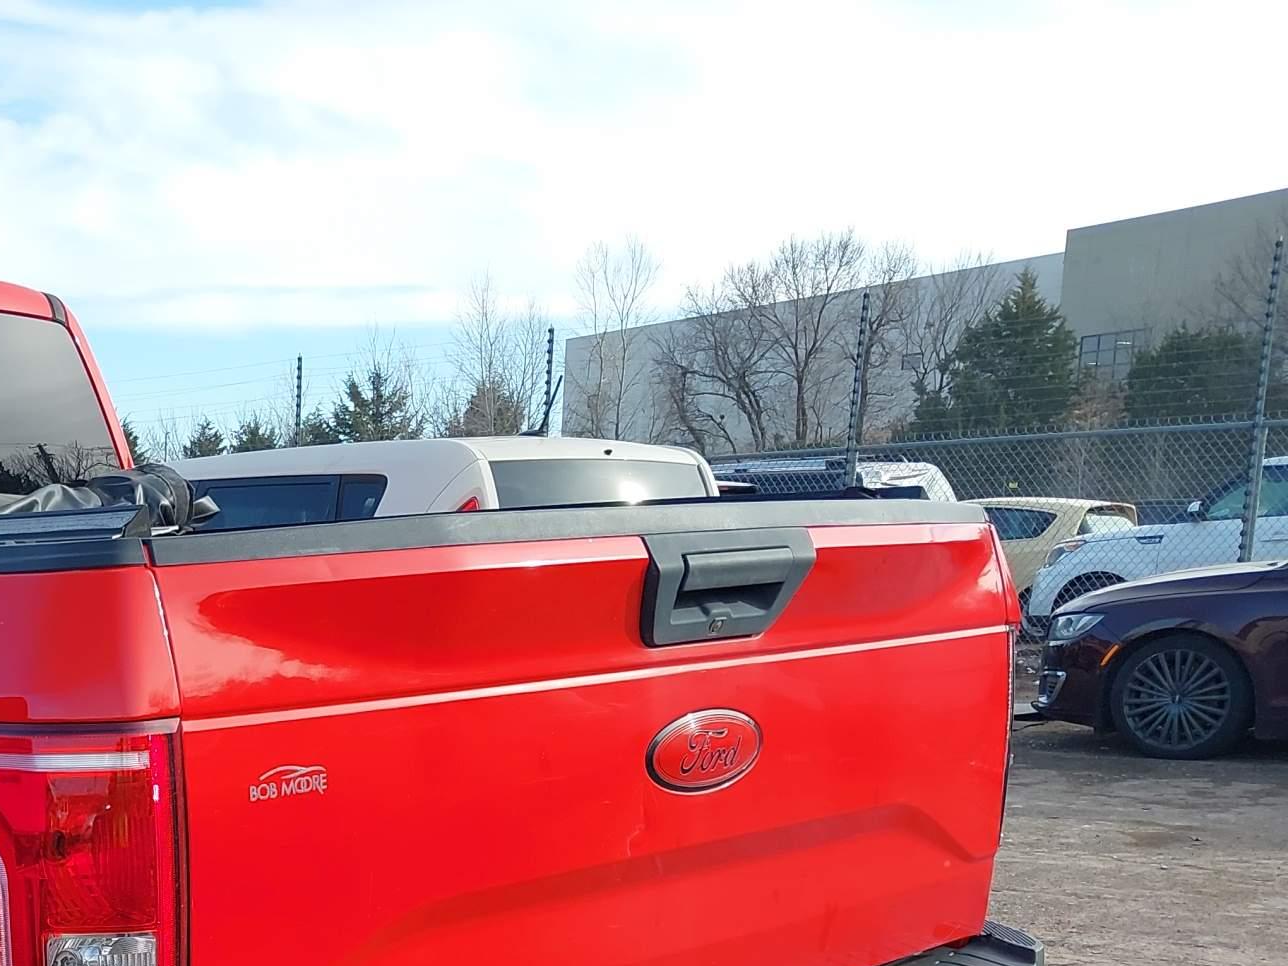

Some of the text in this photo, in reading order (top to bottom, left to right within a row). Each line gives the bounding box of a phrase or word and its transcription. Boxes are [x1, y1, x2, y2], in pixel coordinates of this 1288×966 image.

[679, 727, 743, 776] Ford
[249, 773, 328, 802] BOB MOORE
